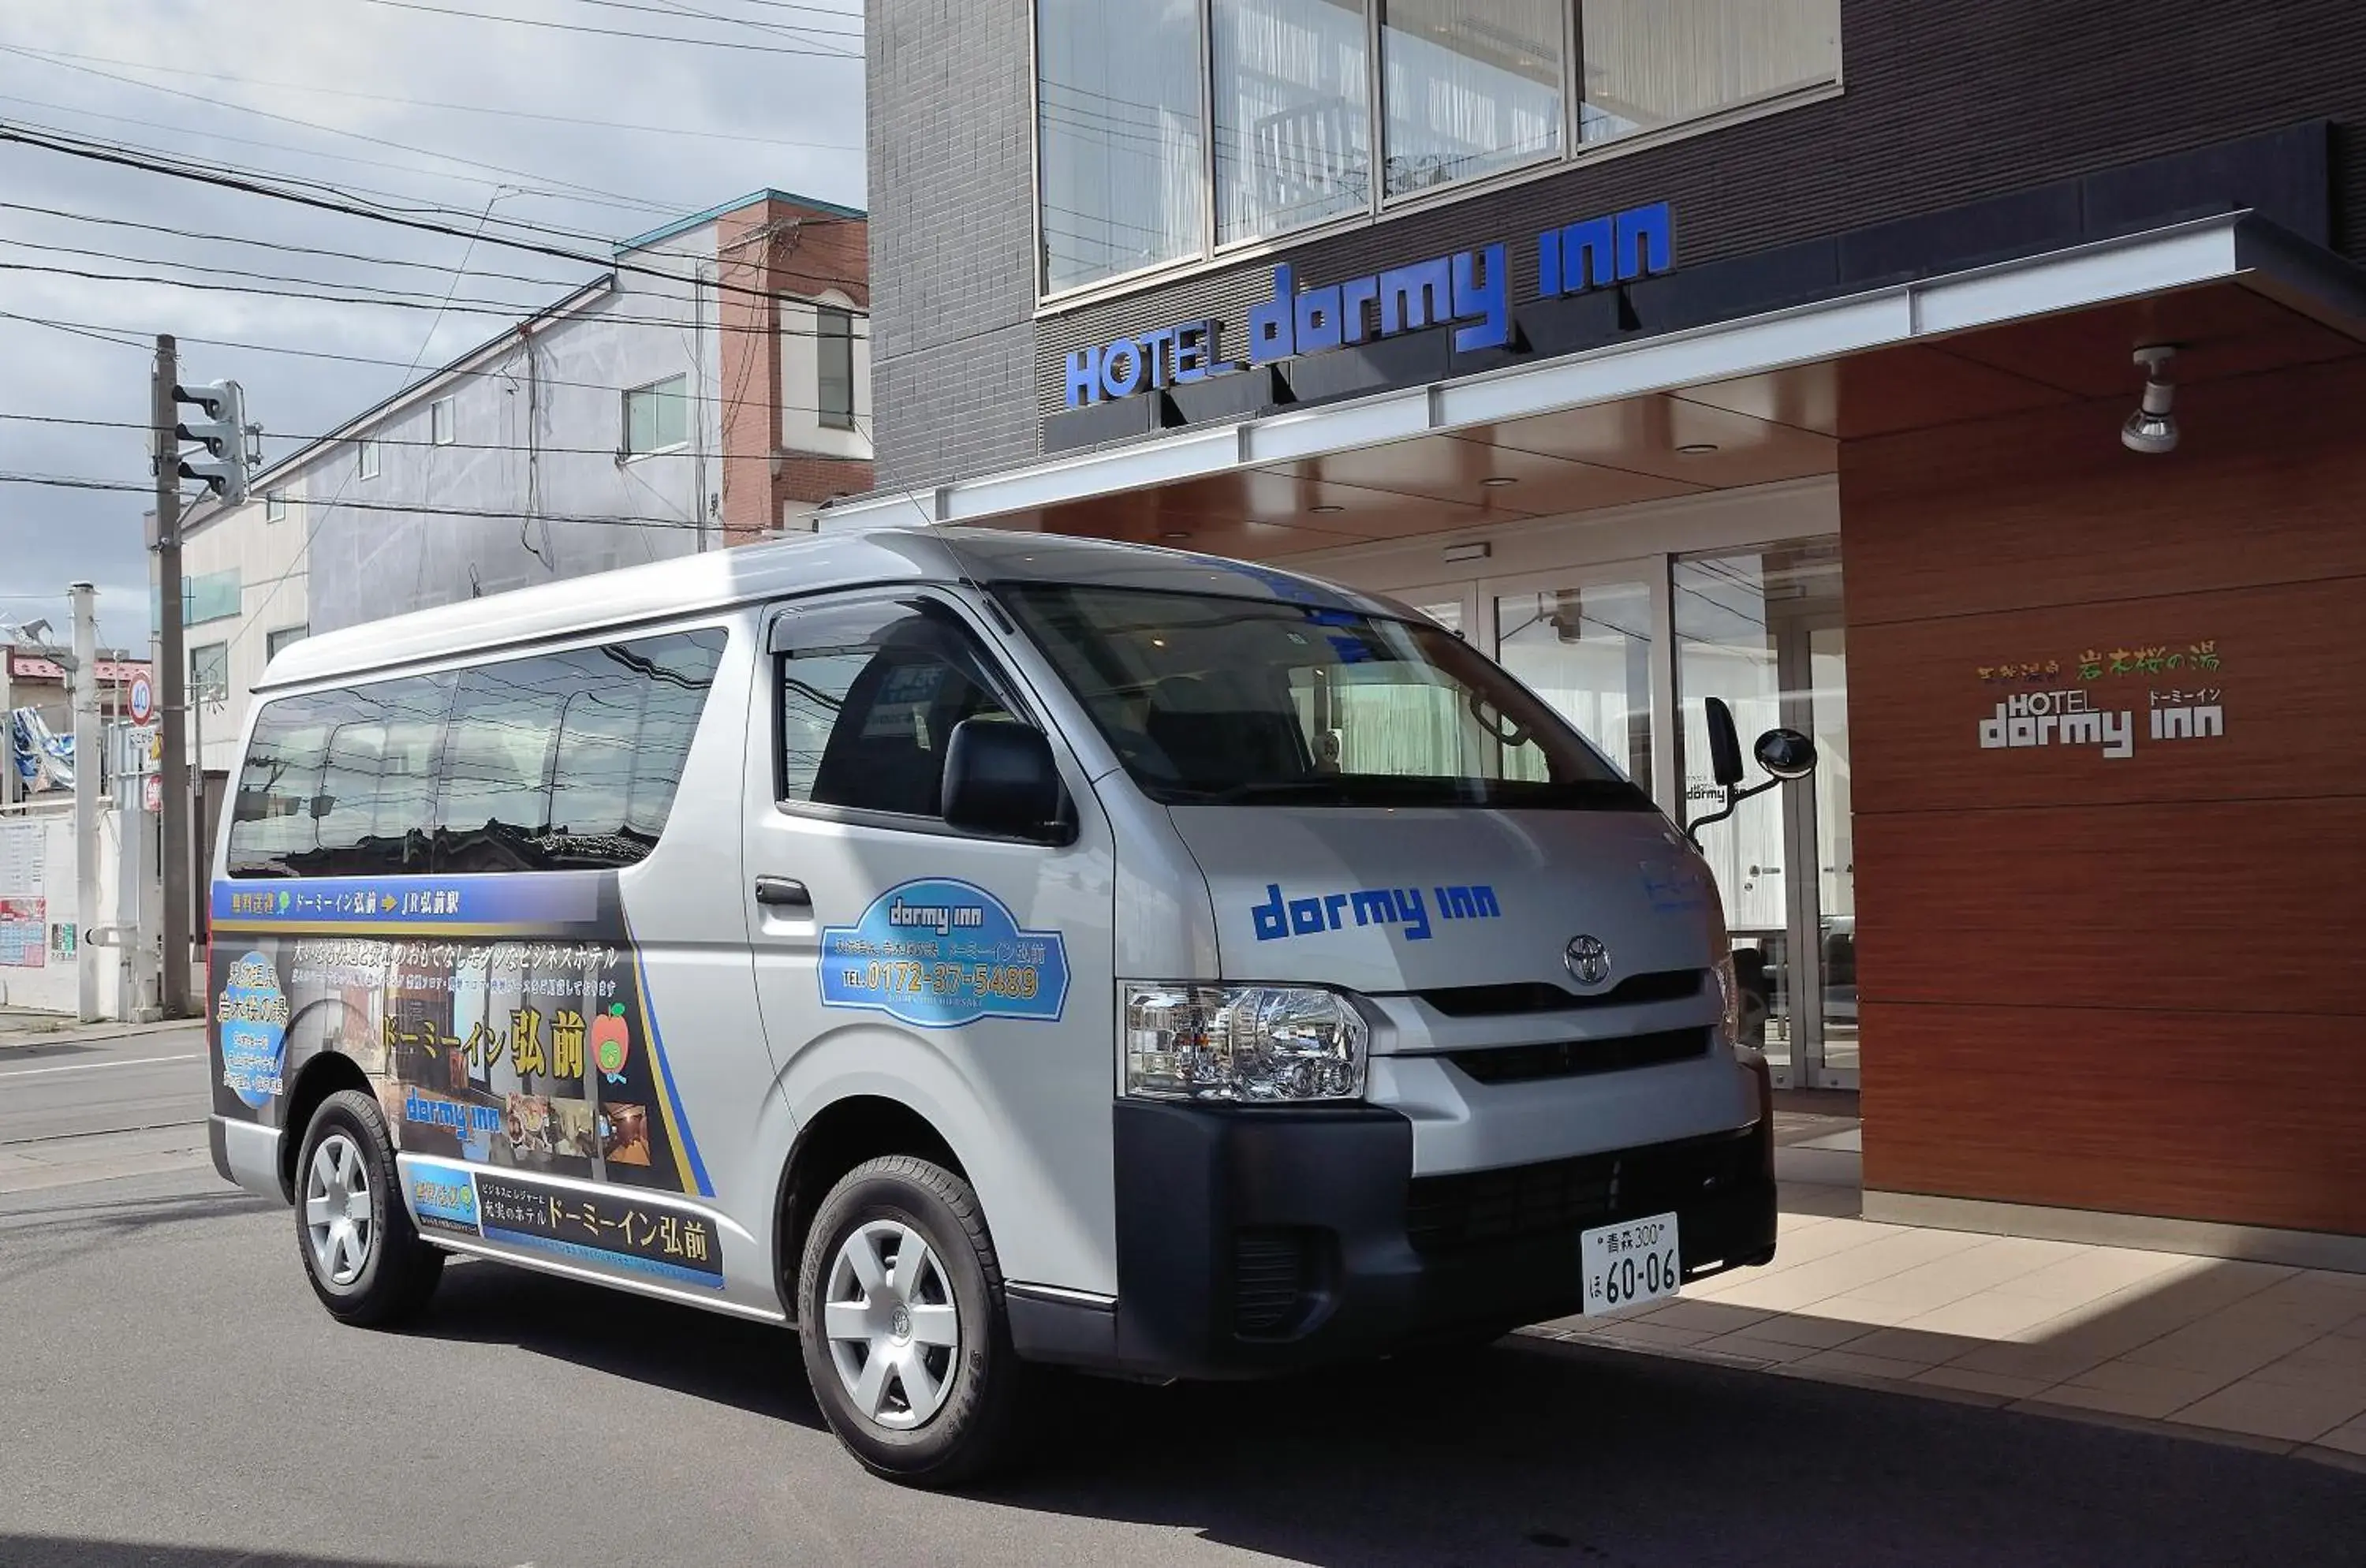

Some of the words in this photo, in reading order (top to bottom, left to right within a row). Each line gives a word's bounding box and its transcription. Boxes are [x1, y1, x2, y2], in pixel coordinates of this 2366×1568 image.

[1065, 319, 1238, 409] HOTEL
[1249, 242, 1507, 365] dormy
[1538, 201, 1670, 298] inn
[133, 685, 147, 710] 40
[2009, 689, 2098, 717] HOTEL
[1979, 703, 2133, 758] dormy
[2150, 705, 2223, 739] inn
[1686, 786, 1725, 803] dormy
[296, 891, 377, 915] ドーミーイン弘前
[401, 890, 460, 916] JR弘前駅
[890, 897, 949, 935] dormy
[952, 906, 983, 927] inn
[1251, 883, 1432, 941] dormy
[1434, 885, 1501, 920] inn
[867, 959, 1039, 999] 0172-37-5489
[383, 1006, 587, 1079] ドーミーイン弘前
[405, 1086, 468, 1141] dormy
[470, 1105, 500, 1133] inn
[484, 1199, 547, 1226] 充実のホテル
[550, 1197, 707, 1260] ドーミーイン弘前
[1590, 1275, 1603, 1299] ほ
[1607, 1249, 1674, 1304] 60-06
